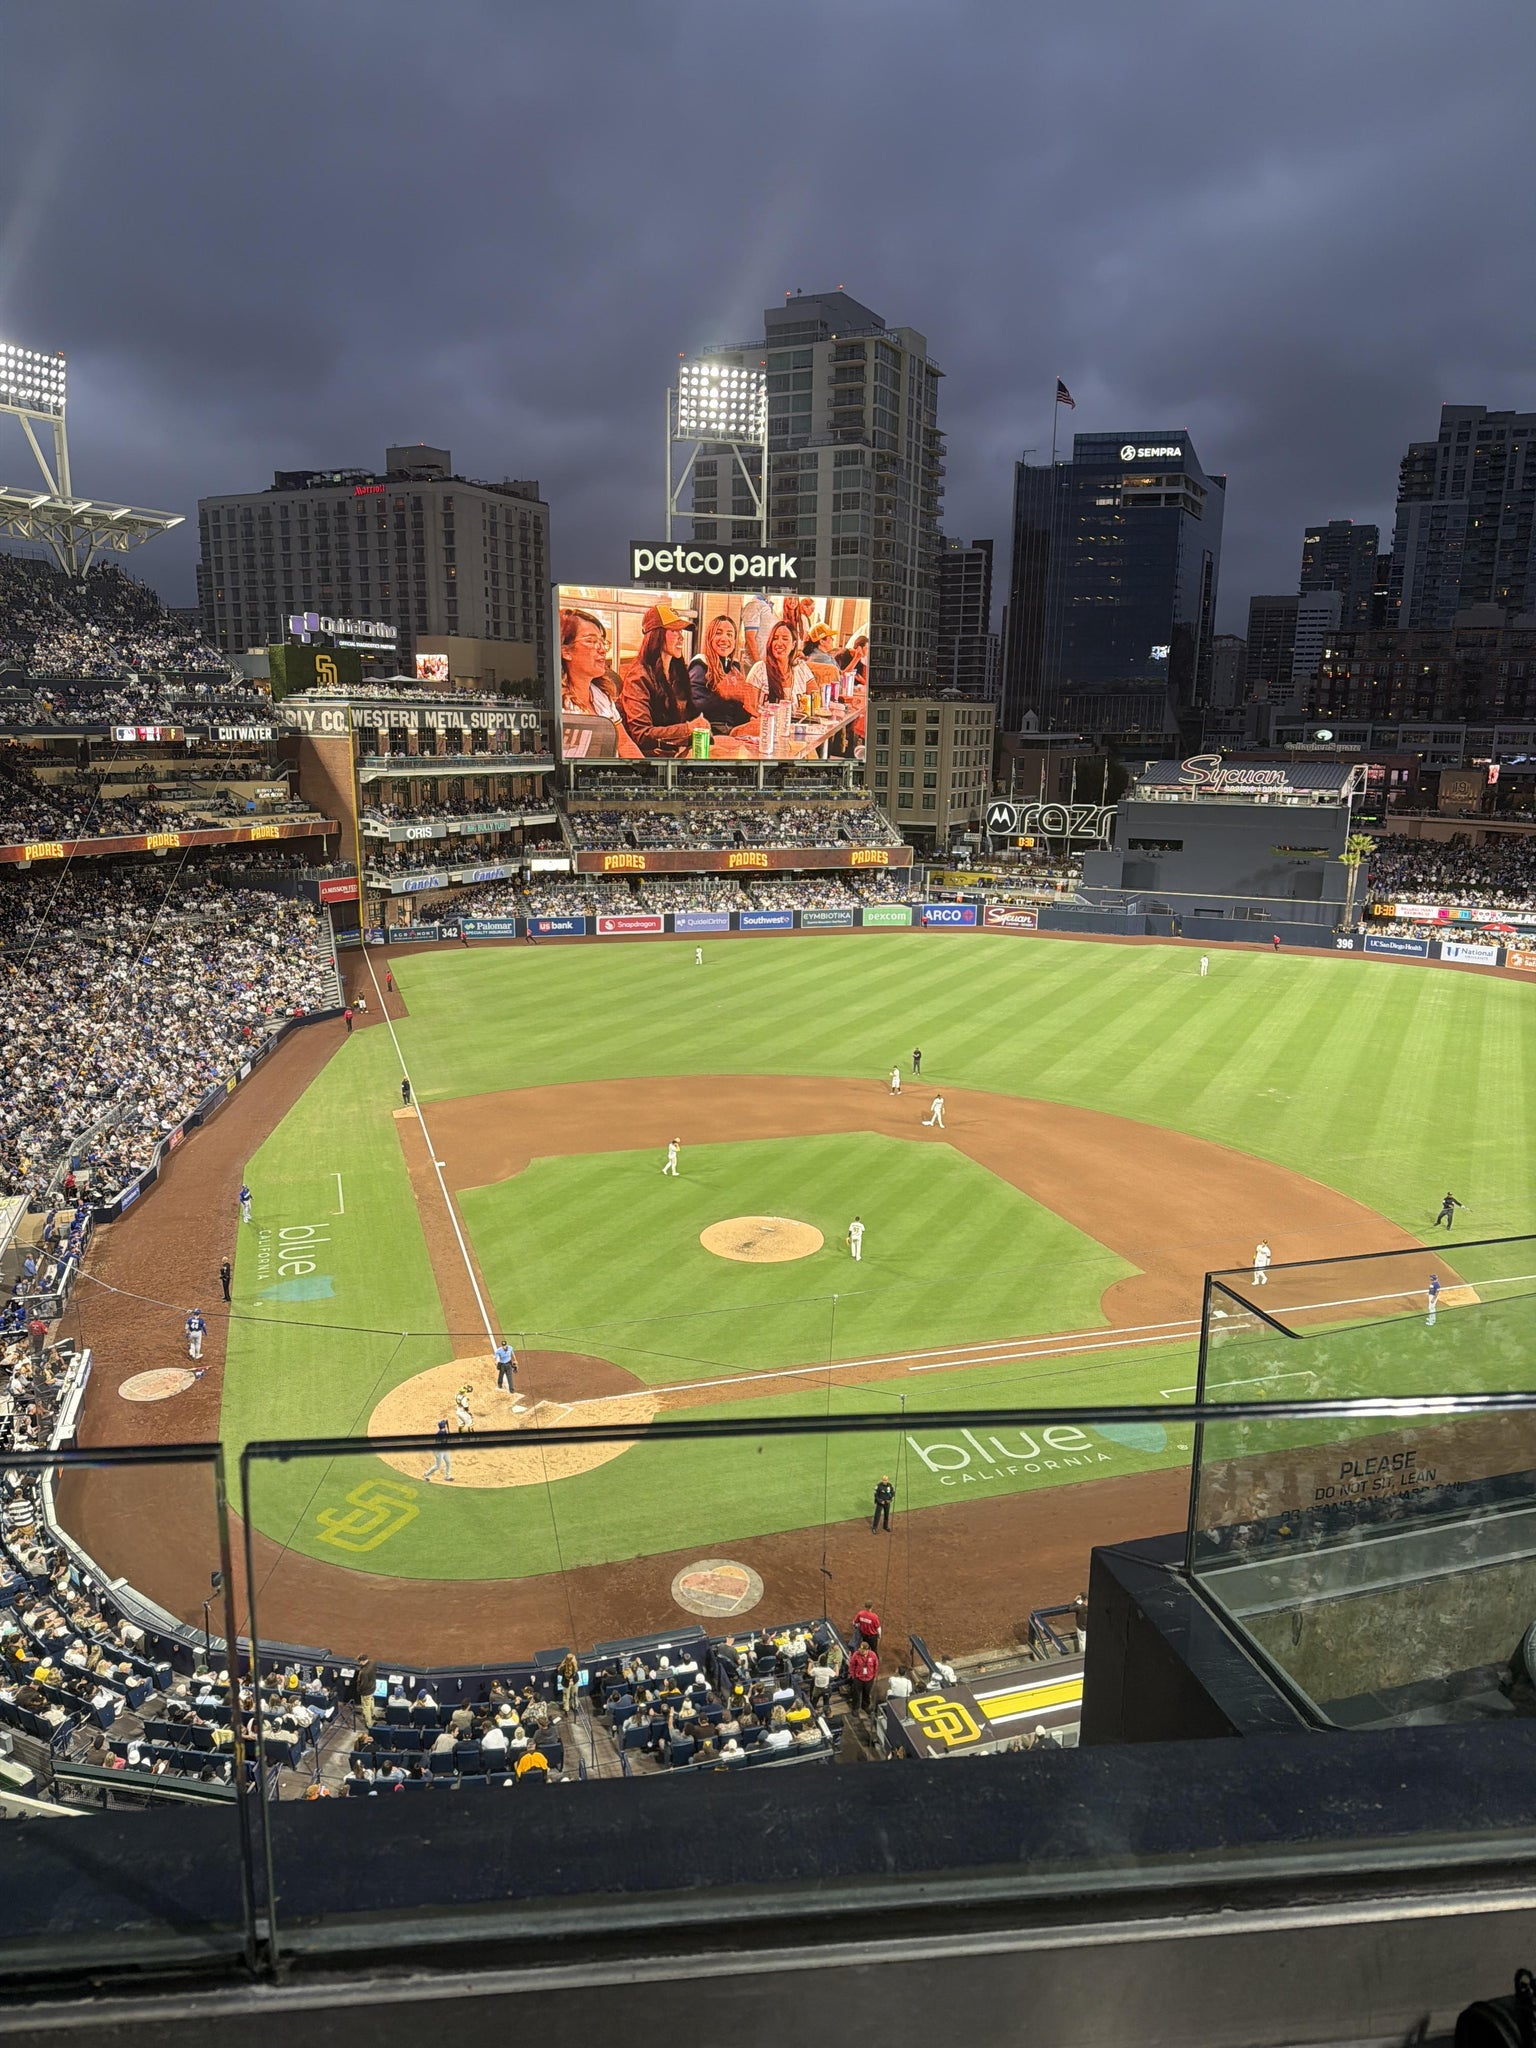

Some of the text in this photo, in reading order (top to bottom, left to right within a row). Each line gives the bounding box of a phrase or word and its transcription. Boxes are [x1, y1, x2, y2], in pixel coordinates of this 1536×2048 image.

[1137, 447, 1181, 457] SEMPRA
[353, 483, 385, 496] Marriott
[634, 545, 797, 582] petco park
[320, 616, 397, 638] QuidelOrtho
[351, 709, 540, 729] WESTERN METAL SUPPLY CO.
[218, 727, 272, 740] CUTWATER
[1179, 754, 1289, 793] Sycuan
[1020, 803, 1118, 838] razr
[147, 833, 180, 849] PADRES
[251, 826, 280, 840] PADRES
[406, 827, 432, 839] ORIS
[25, 843, 64, 861] PADRES
[729, 852, 768, 868] PADRES
[851, 849, 888, 866] PADRES
[604, 853, 646, 870] PADRES
[368, 890, 381, 900] 336
[688, 918, 728, 927] QuidelOrtho
[743, 916, 783, 925] Southwest
[926, 910, 961, 921] ARCO
[987, 908, 1032, 926] Sycuan
[441, 927, 458, 938] 342
[476, 922, 512, 931] Palomar
[539, 921, 573, 930] us bank
[617, 921, 656, 929] Snapdragon
[1336, 938, 1354, 949] 396
[1389, 942, 1404, 950] Diego
[1405, 943, 1422, 951] Health
[1461, 948, 1493, 957] National
[257, 1229, 272, 1280] CALIFORNIA
[278, 1223, 331, 1276] blue
[906, 1425, 1093, 1473] blue
[940, 1452, 1111, 1486] CALIFORNIA
[1340, 1450, 1417, 1480] PLEASE
[1314, 1468, 1437, 1501] DO NOT SIT, LEAN
